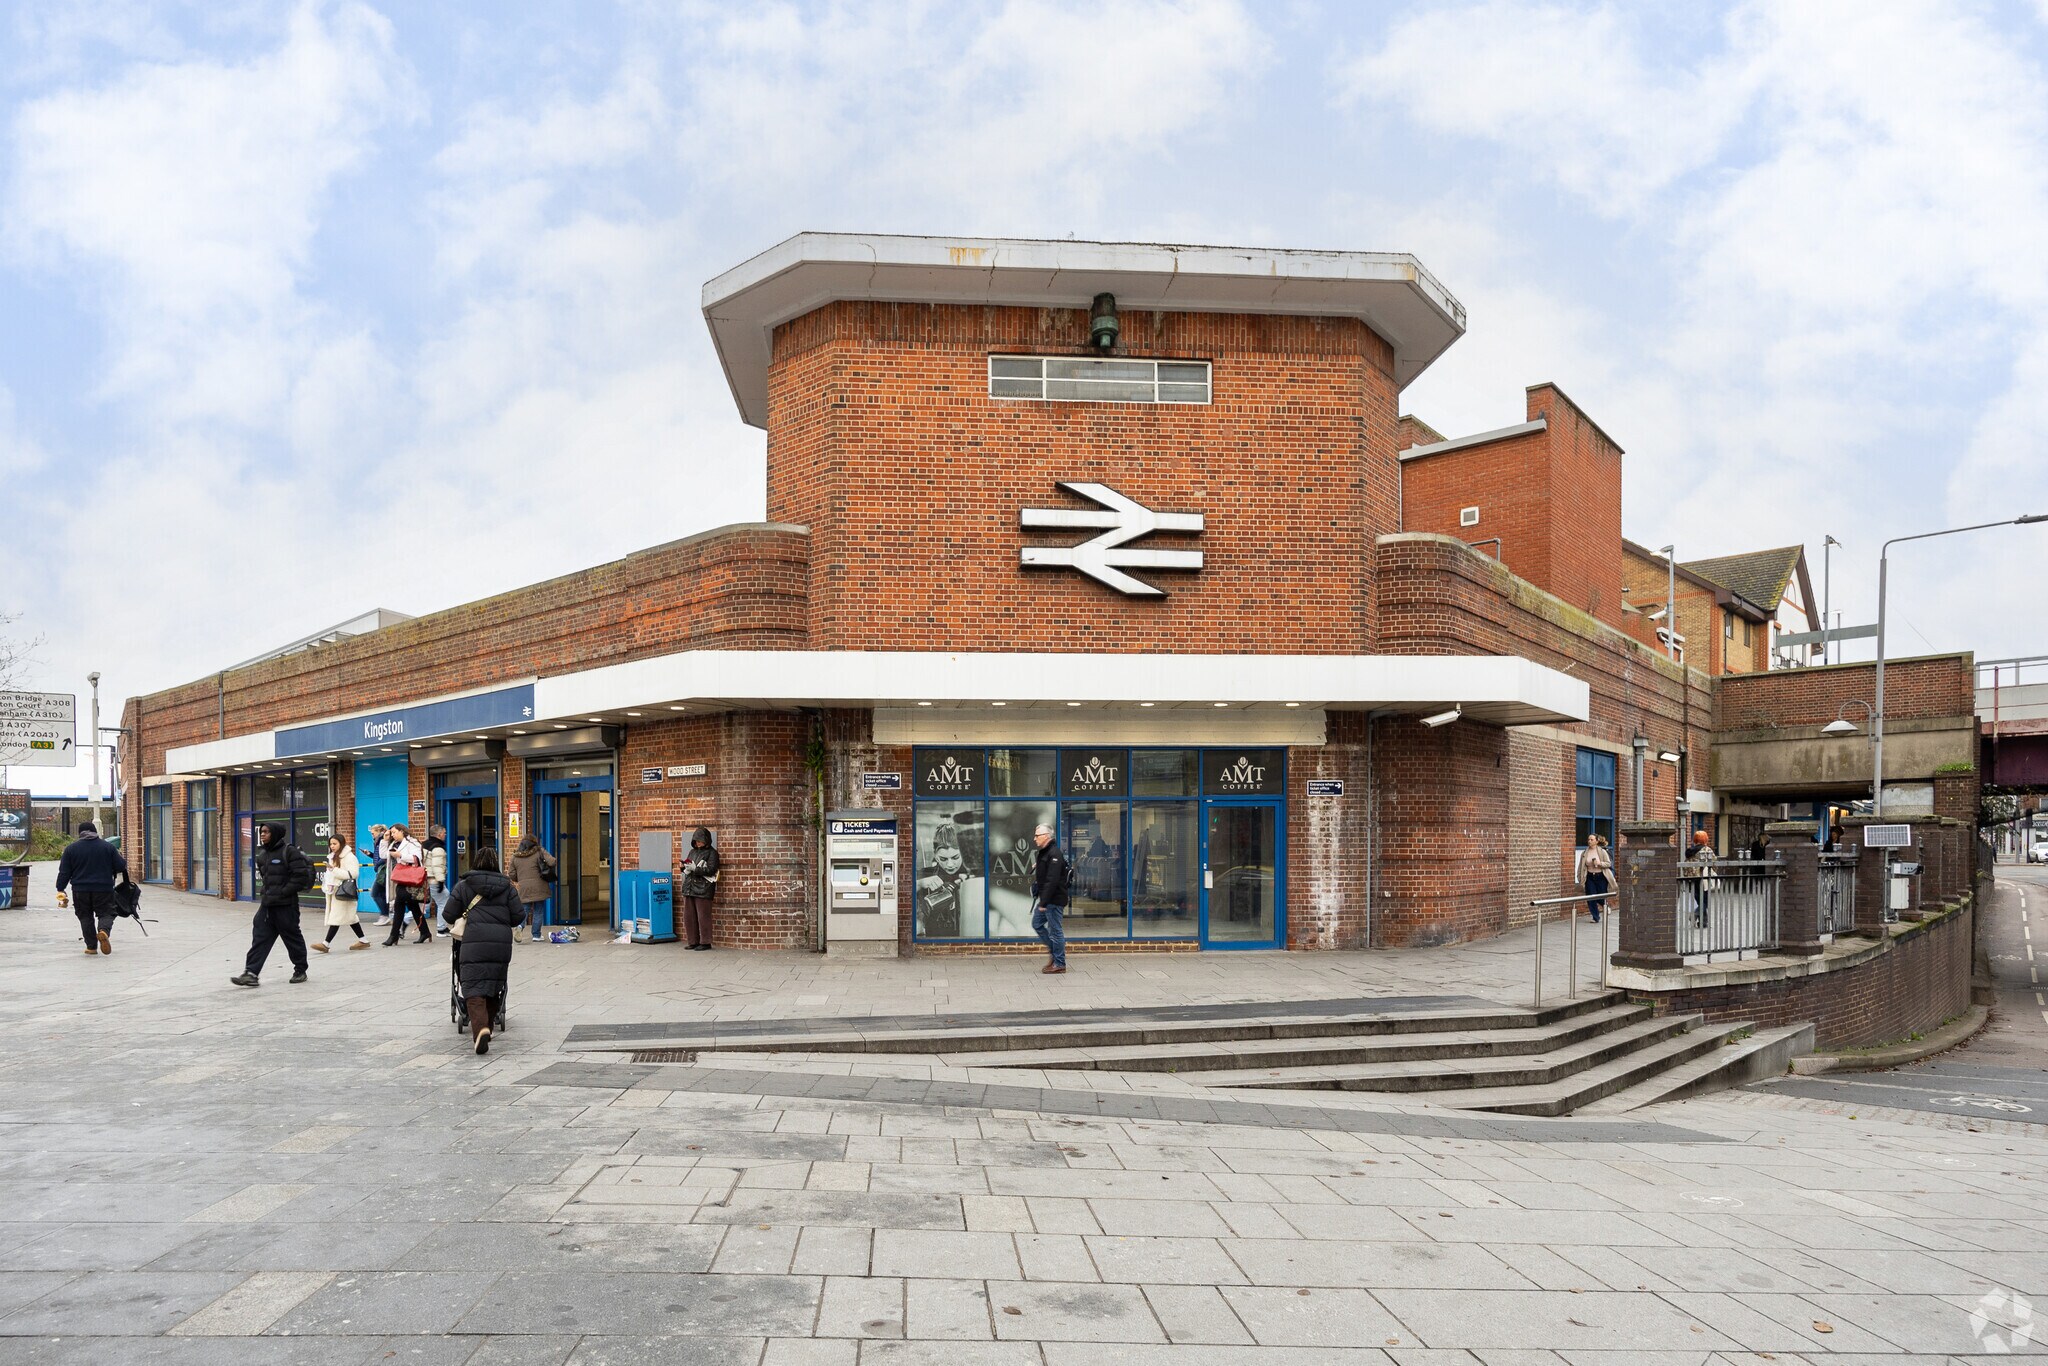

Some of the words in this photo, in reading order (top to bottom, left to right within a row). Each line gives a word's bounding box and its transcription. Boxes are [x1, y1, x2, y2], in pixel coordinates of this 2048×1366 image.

[364, 720, 403, 740] Kingston
[669, 767, 683, 775] WOOD
[685, 766, 704, 774] STREET
[927, 765, 974, 784] AMT
[1071, 765, 1118, 783] AMT
[1220, 765, 1266, 783] AMT
